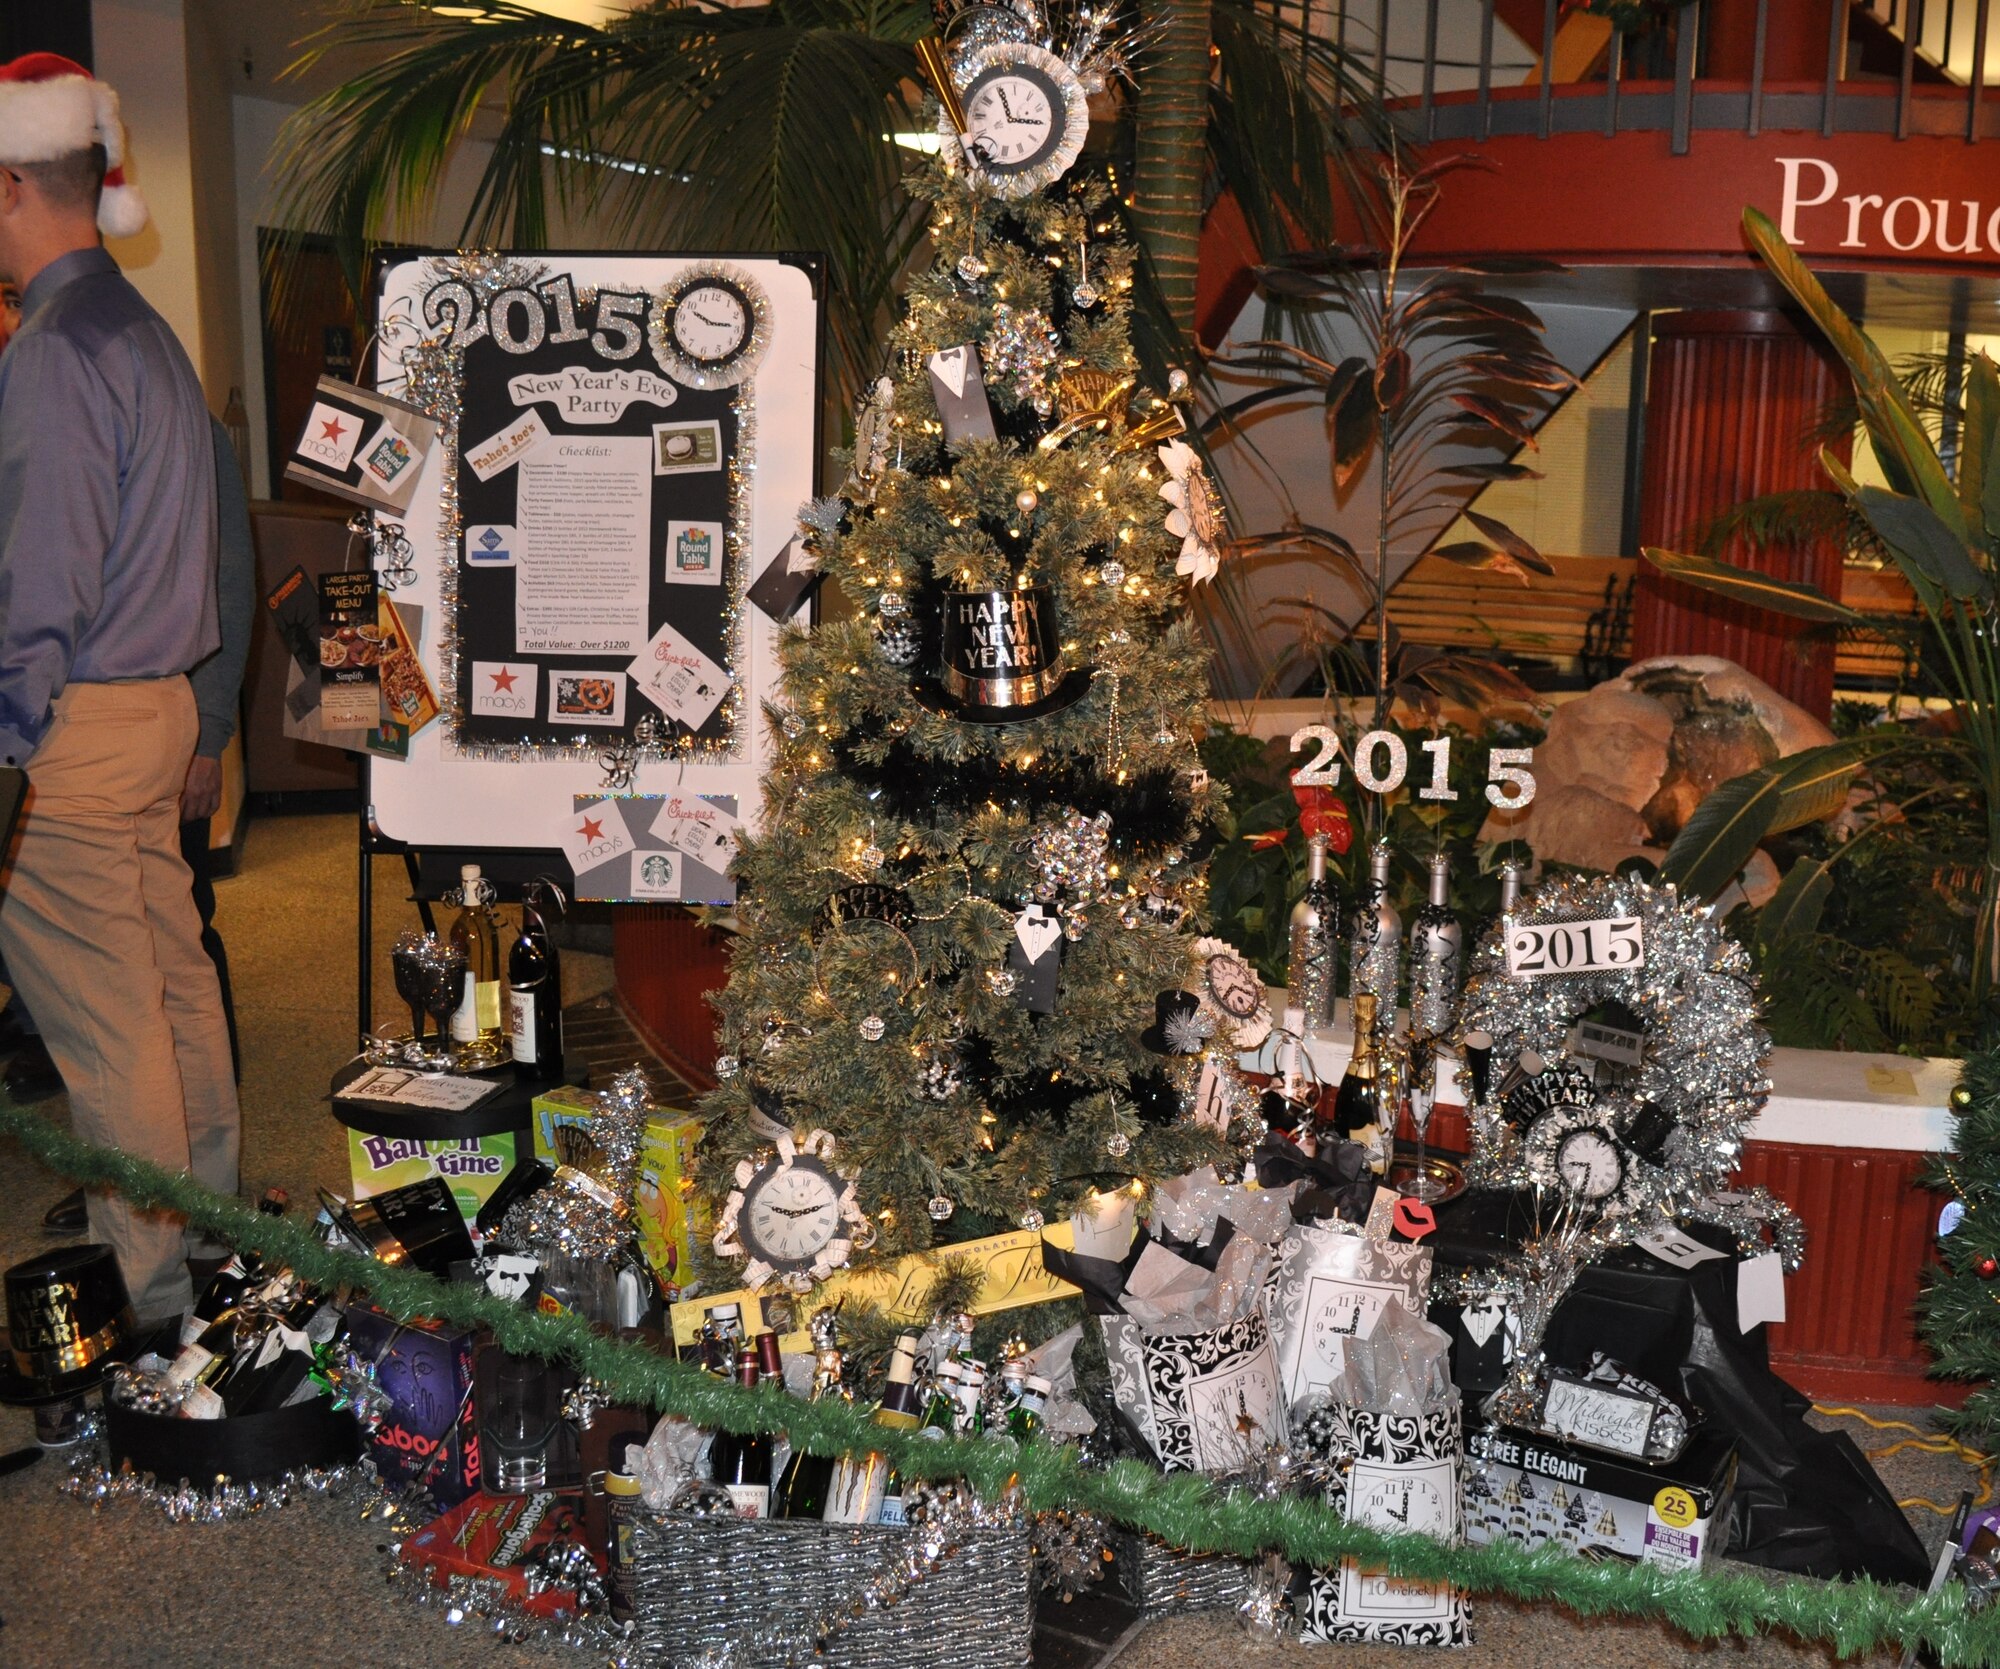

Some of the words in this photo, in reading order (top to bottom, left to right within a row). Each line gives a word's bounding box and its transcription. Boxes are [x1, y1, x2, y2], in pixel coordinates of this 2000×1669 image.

[1774, 157, 2000, 254] Prou
[423, 272, 654, 360] 2015
[514, 376, 564, 400] New
[568, 371, 629, 391] Year's
[634, 375, 672, 401] Eve
[568, 396, 622, 418] Party
[473, 442, 510, 471] Tahoe
[509, 423, 536, 447] Joe's
[559, 445, 612, 457] Checklist:
[379, 443, 405, 470] Round
[373, 453, 394, 477] Table
[680, 541, 709, 553] Round
[682, 552, 705, 564] Table
[326, 575, 347, 584] LARGE
[348, 575, 370, 583] PARTY
[324, 583, 372, 597] TAKE-OUT
[335, 598, 362, 608] MENU
[959, 600, 1039, 624] HAPPY
[971, 623, 1028, 647] NEW
[524, 640, 546, 649] Total
[548, 640, 576, 649] Value:
[580, 640, 601, 649] Over
[603, 640, 630, 649] $1200
[965, 645, 1037, 669] YEAR!
[336, 671, 365, 683] Simplify
[332, 714, 351, 723] Tahoe
[1513, 921, 1641, 972] 2015
[435, 1153, 501, 1176] time
[1338, 1296, 1349, 1308] 11
[1354, 1294, 1366, 1306] 12
[1324, 1306, 1337, 1318] 10
[1553, 1386, 1646, 1432] Midnight
[1523, 1447, 1588, 1485] ÉLÉGANT
[1385, 1484, 1397, 1494] 11
[1401, 1479, 1414, 1490] 12
[1371, 1495, 1384, 1506] 10
[1663, 1495, 1687, 1516] 25
[493, 1491, 553, 1567] Scattergories
[1654, 1525, 1683, 1539] ENSEMBLE
[1669, 1536, 1691, 1549] VALEUR
[1367, 1580, 1389, 1596] 10
[1392, 1585, 1430, 1597] o'clock
